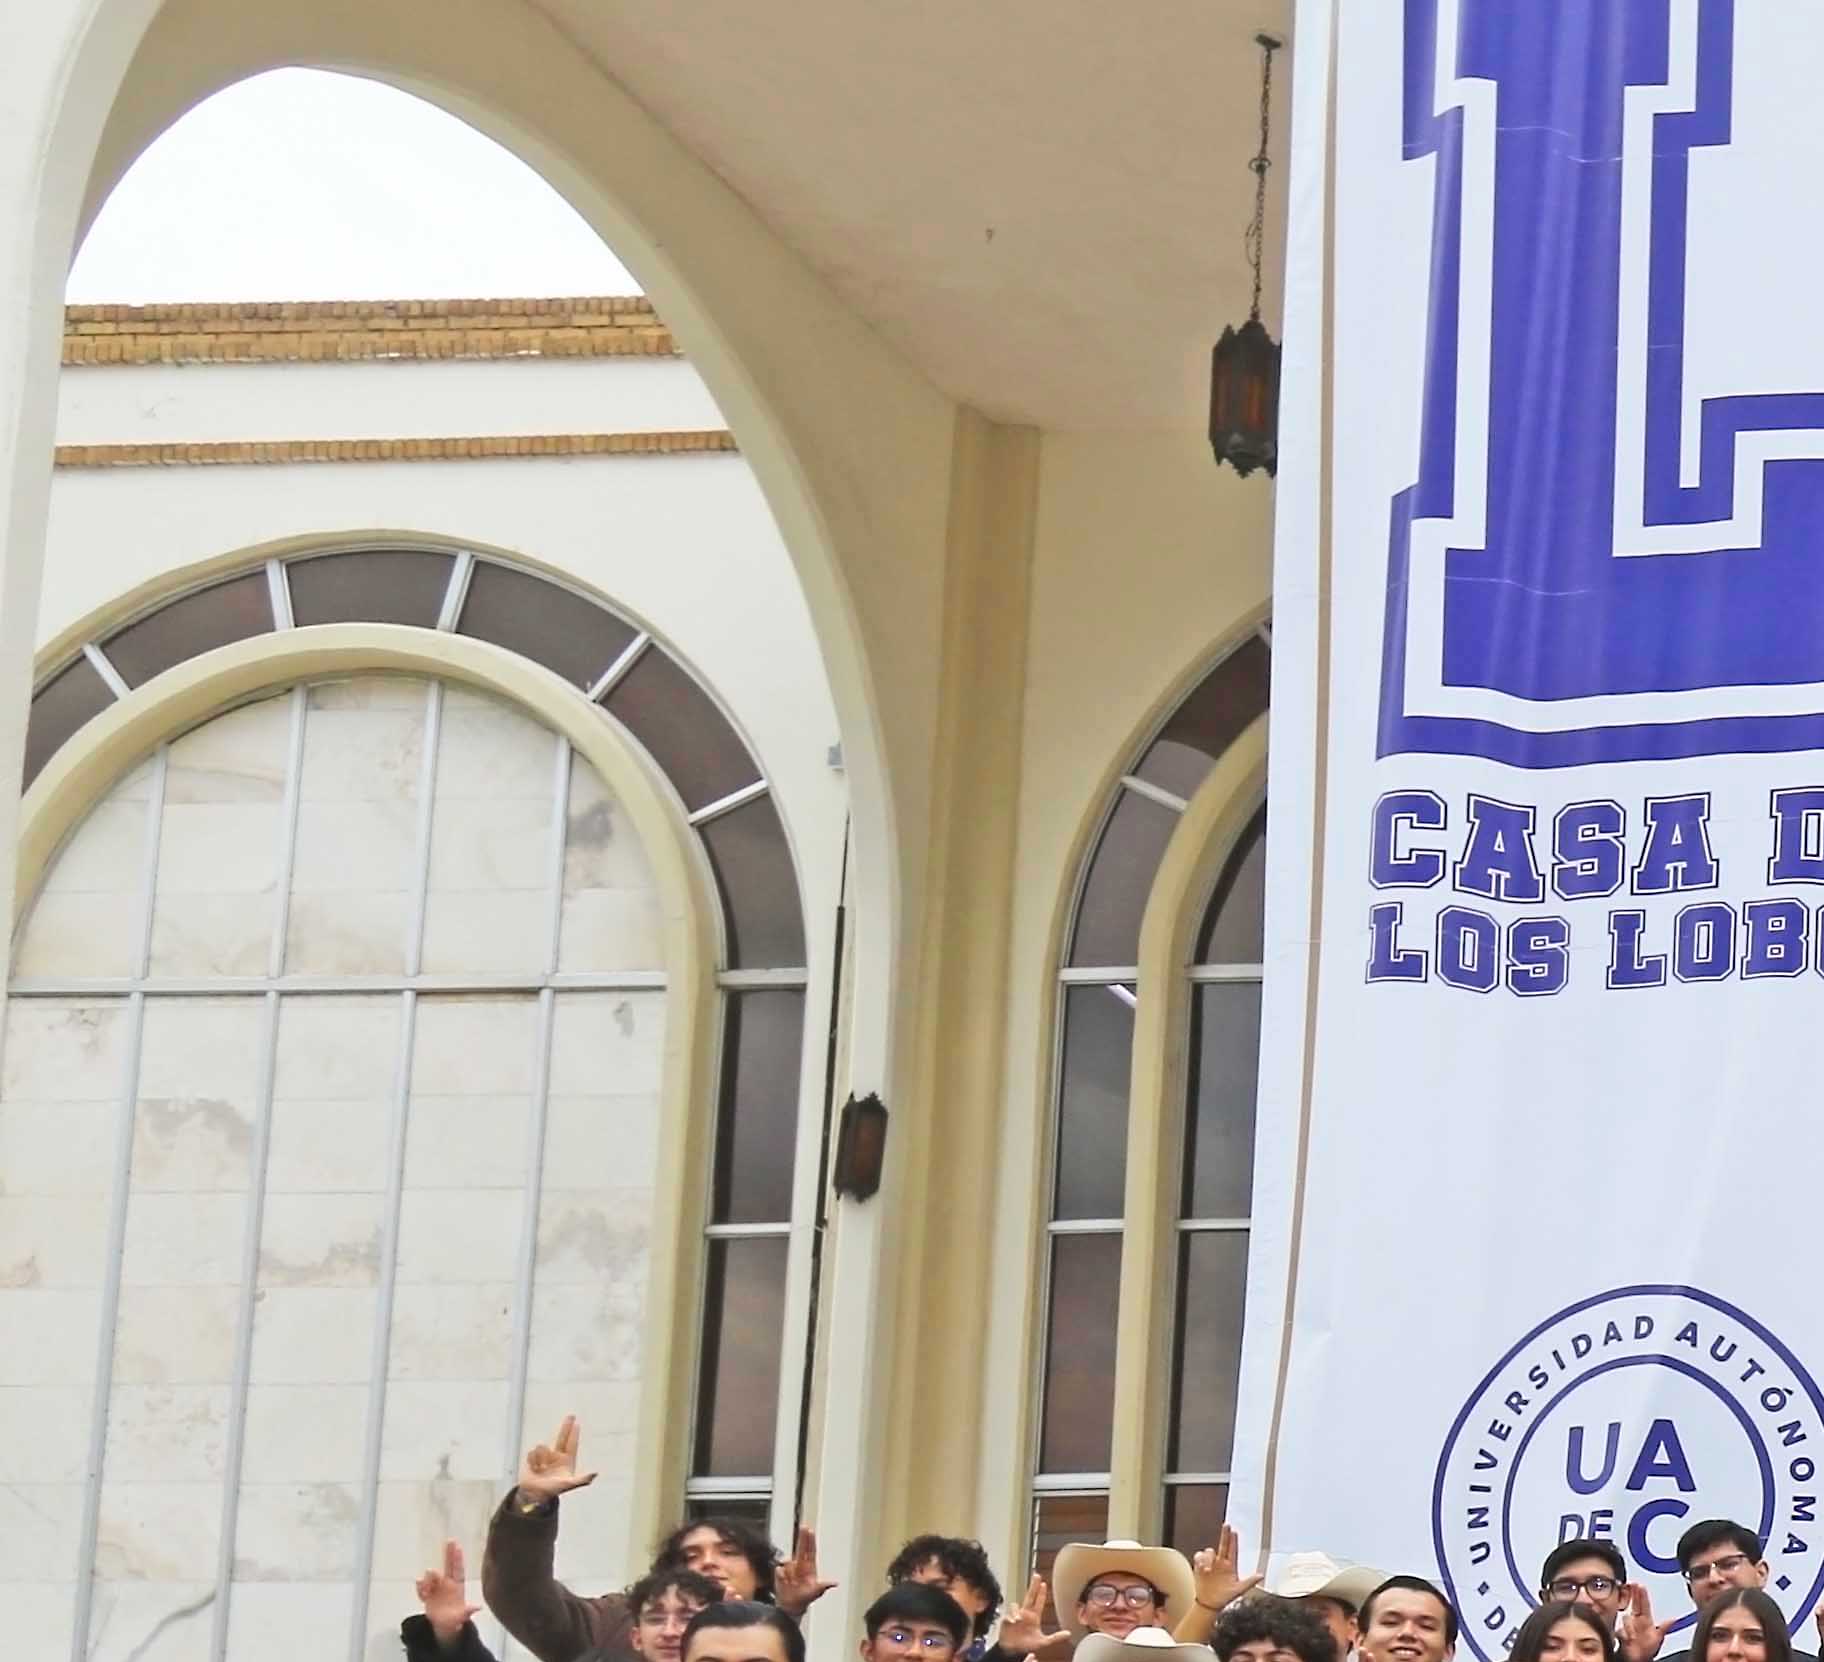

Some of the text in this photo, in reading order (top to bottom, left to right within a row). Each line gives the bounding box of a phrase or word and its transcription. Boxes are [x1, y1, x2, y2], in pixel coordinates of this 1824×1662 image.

[1367, 789, 1719, 903] CASA
[1365, 901, 1571, 997] LOS
[1467, 1315, 1817, 1566] UNIVERSIDAD AUTÓNOMA
[1565, 1418, 1697, 1496] UA
[1557, 1498, 1691, 1575] DE C
